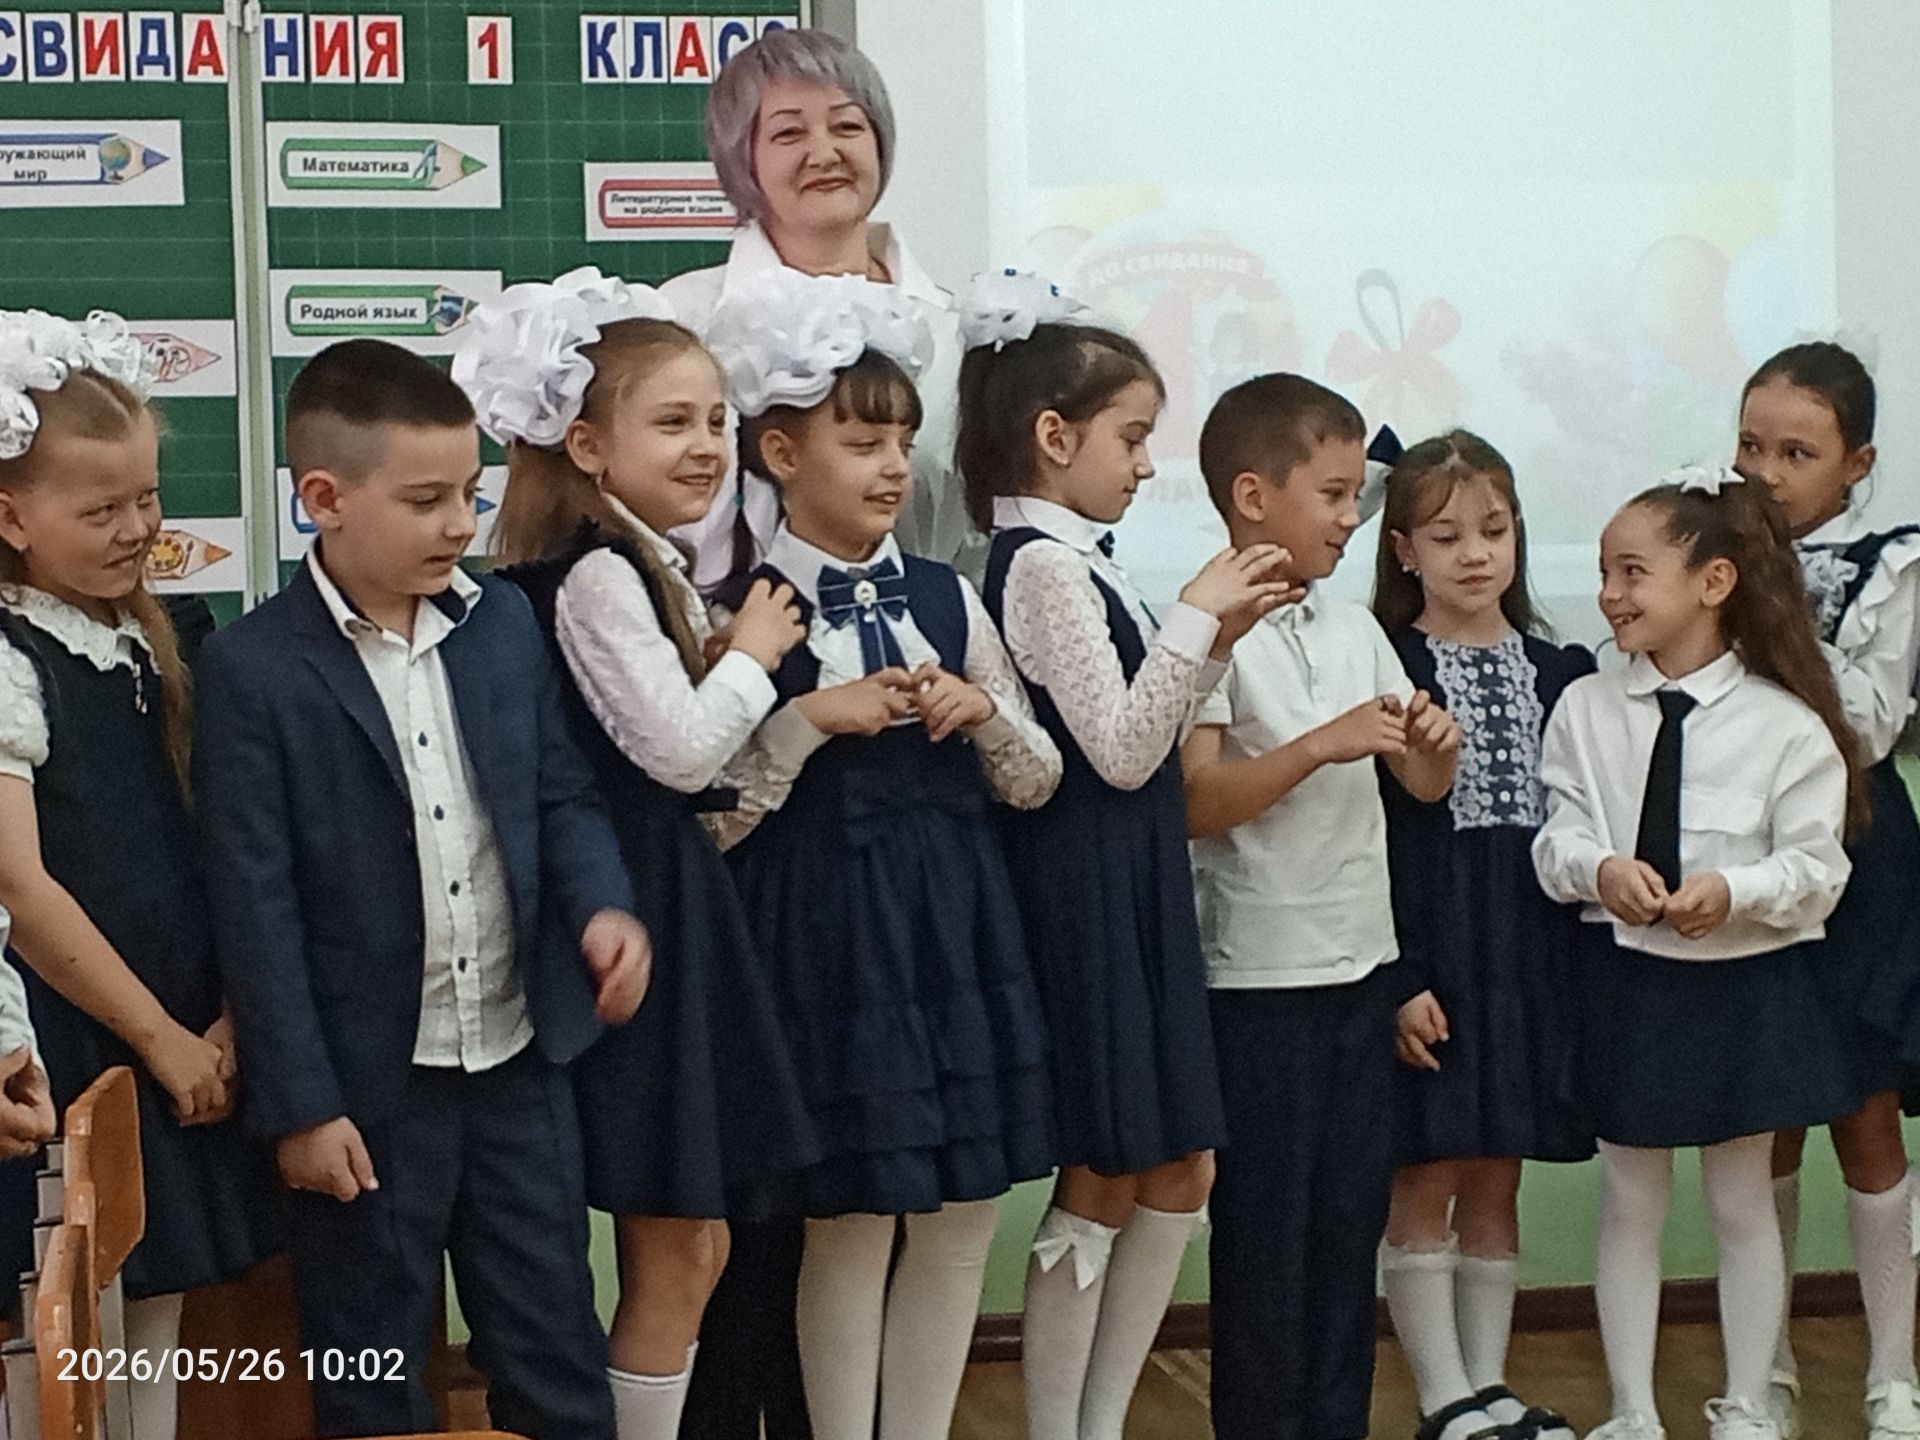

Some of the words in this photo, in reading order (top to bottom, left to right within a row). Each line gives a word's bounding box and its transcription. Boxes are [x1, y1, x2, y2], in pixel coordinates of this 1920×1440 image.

[478, 22, 499, 79] 1
[586, 20, 785, 79] КЛАС
[302, 156, 410, 173] Математика
[14, 169, 48, 184] мир
[300, 303, 368, 320] Родной
[373, 306, 418, 319] язык
